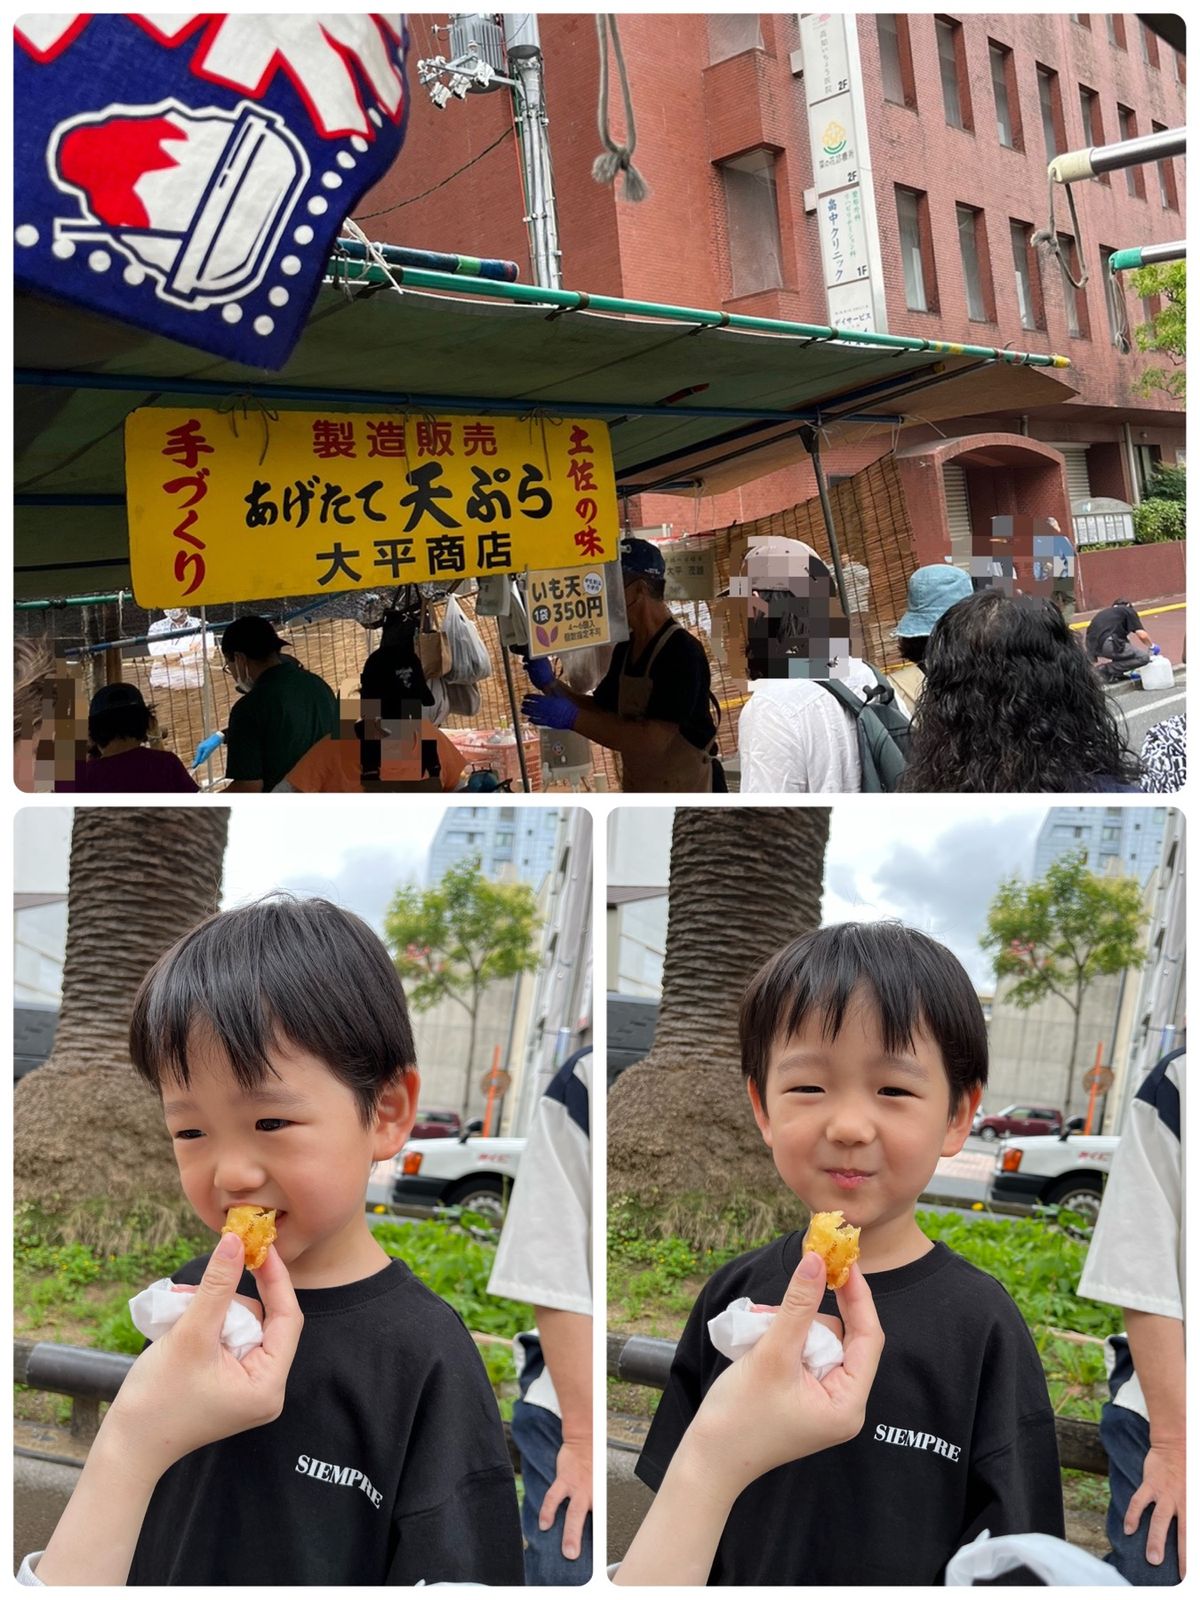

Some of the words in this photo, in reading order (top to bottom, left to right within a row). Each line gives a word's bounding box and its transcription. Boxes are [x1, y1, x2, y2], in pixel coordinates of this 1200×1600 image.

[838, 79, 848, 91] 2F
[847, 170, 857, 182] 2F
[857, 265, 867, 277] 1F
[835, 312, 871, 326] デイサービス
[312, 419, 498, 459] 製造販売
[567, 425, 605, 557] 土佐の味
[162, 419, 215, 597] 手づくり
[316, 531, 512, 586] 大平商店
[532, 575, 581, 602] いも天
[553, 596, 603, 622] 350円
[874, 1423, 961, 1462] SIEMPRE
[295, 1454, 383, 1509] SIEMPRE
